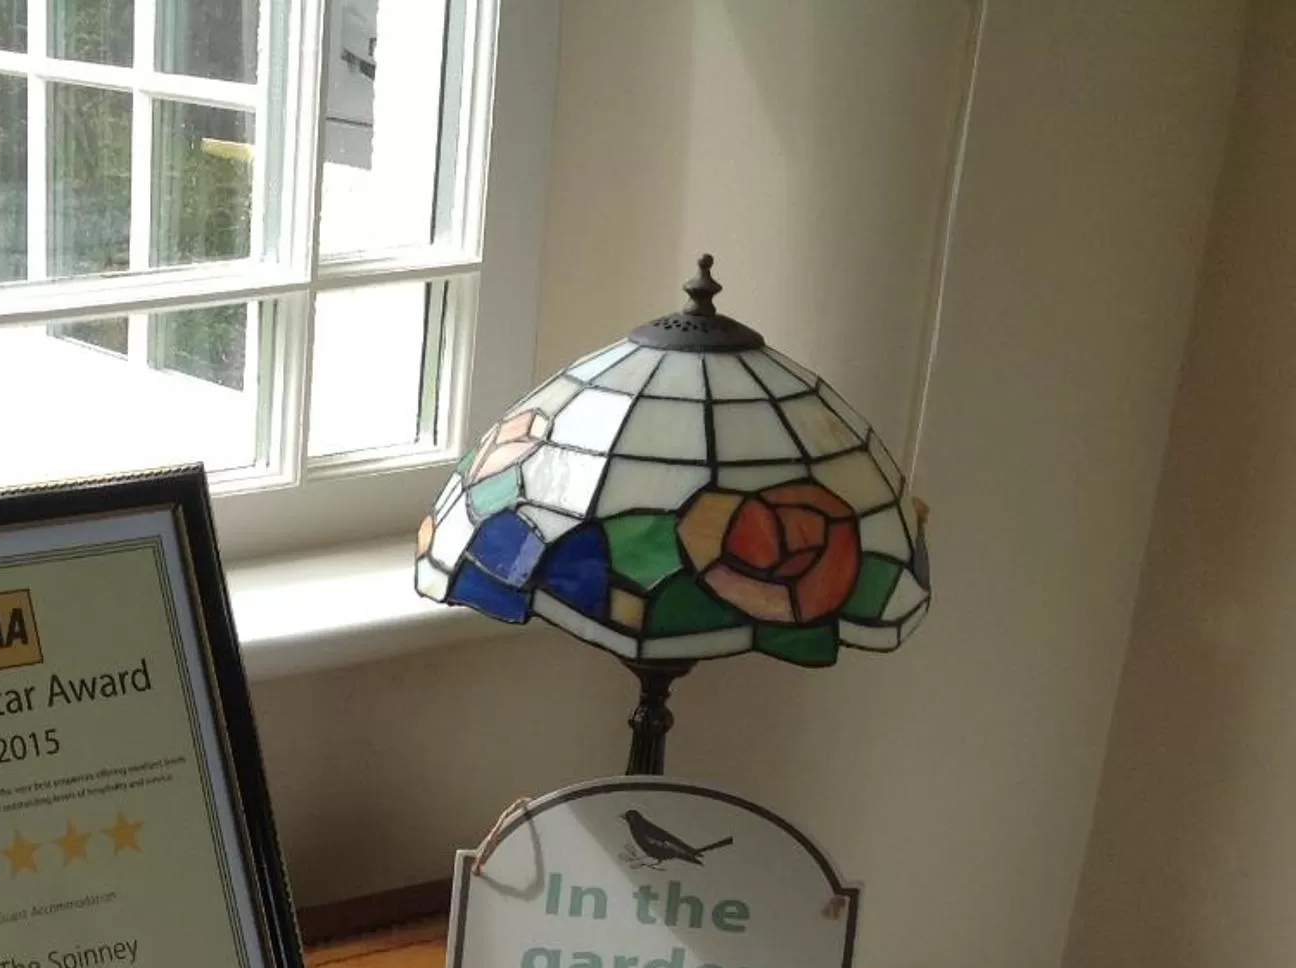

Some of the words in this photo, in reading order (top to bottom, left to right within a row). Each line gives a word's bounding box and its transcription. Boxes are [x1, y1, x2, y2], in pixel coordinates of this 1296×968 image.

[47, 657, 152, 707] Award
[544, 872, 608, 920] In
[632, 880, 751, 933] the
